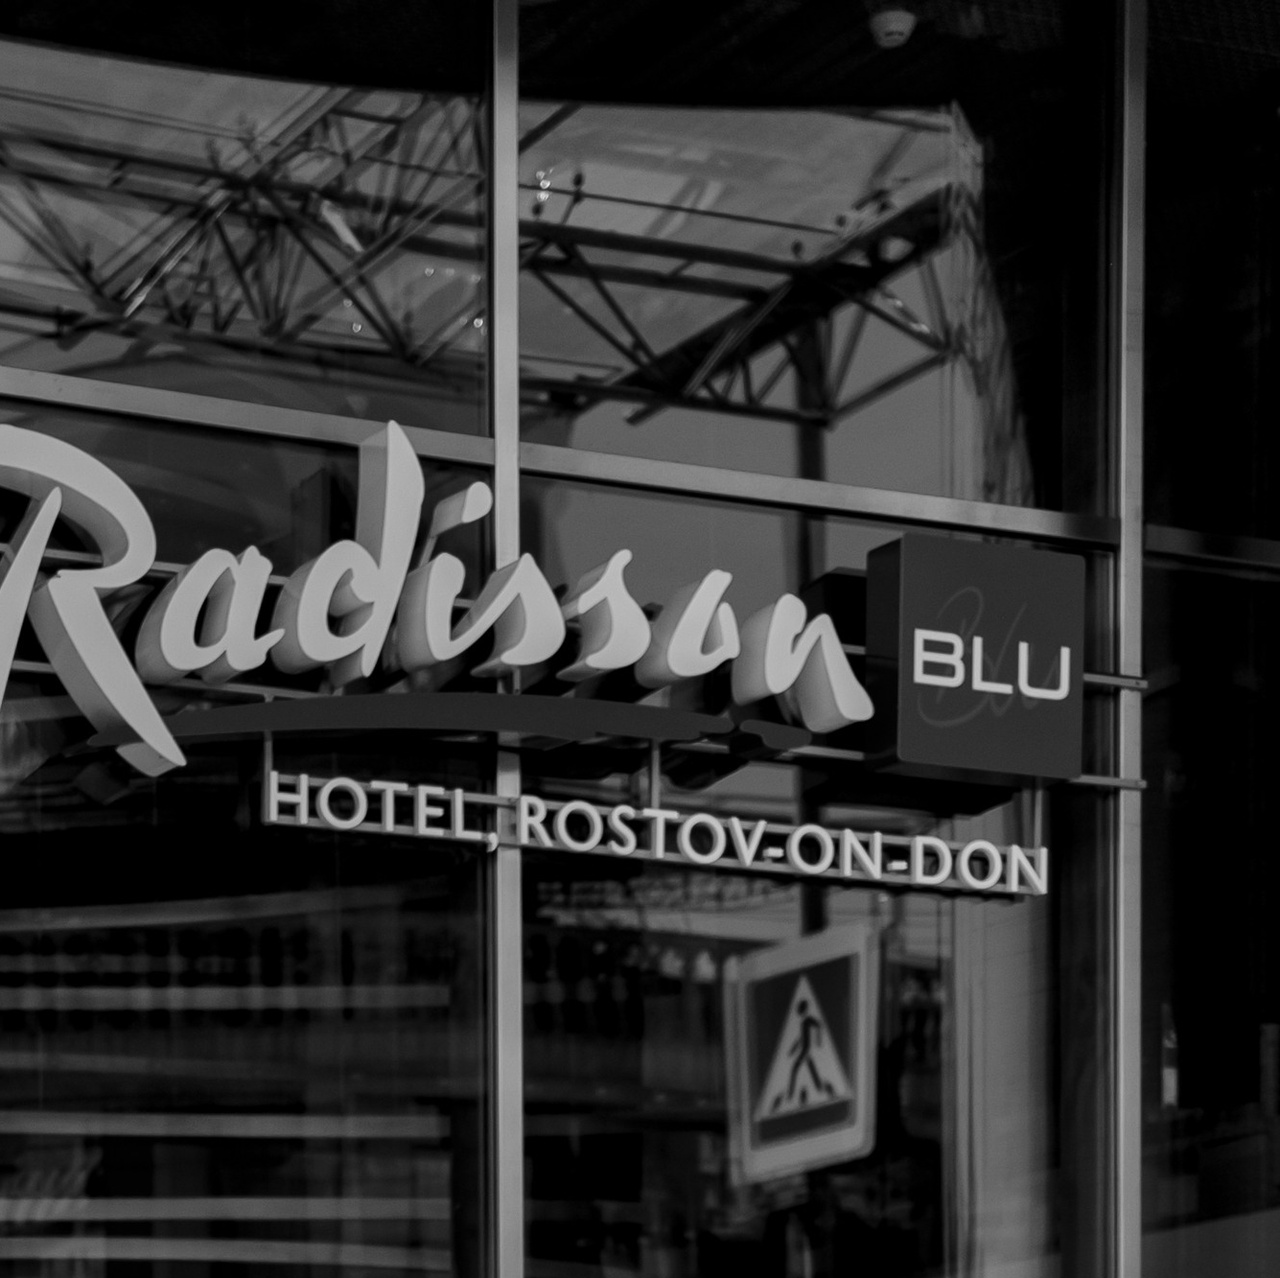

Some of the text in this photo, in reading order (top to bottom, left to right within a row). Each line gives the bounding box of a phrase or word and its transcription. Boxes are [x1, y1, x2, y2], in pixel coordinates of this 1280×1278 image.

[913, 628, 1071, 700] BLU
[267, 769, 1049, 896] HOTEL, ROSTOV-ON-DON
